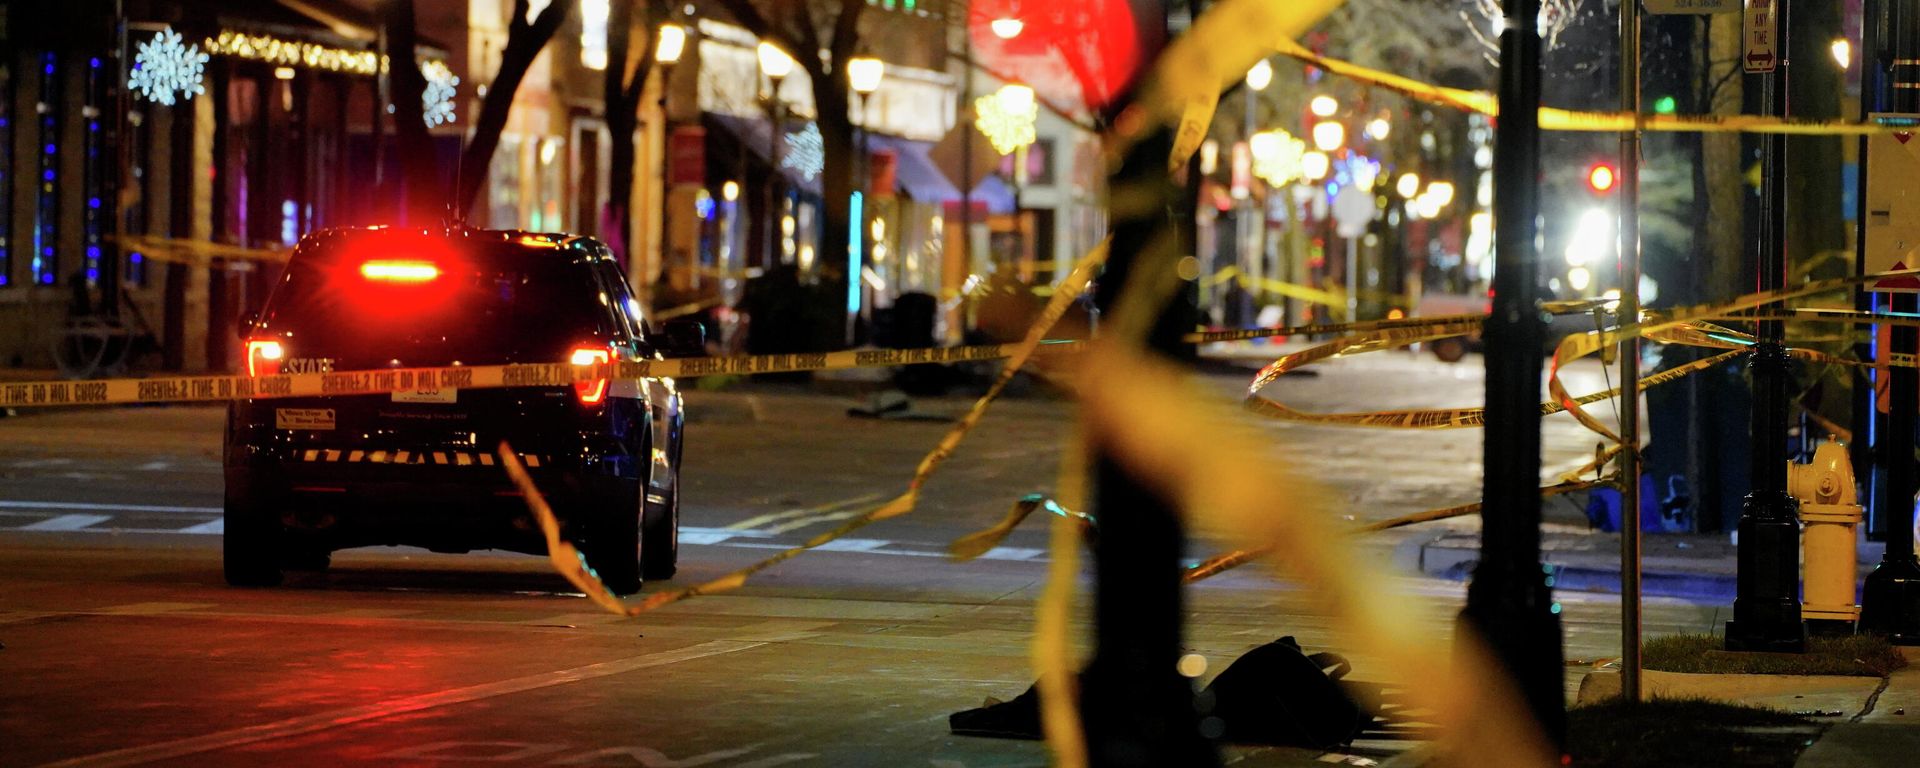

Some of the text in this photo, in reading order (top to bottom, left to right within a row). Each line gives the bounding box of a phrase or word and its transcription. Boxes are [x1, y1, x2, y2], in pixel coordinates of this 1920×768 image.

[1754, 13, 1768, 27] ANY
[1753, 30, 1768, 45] TIME
[288, 358, 335, 375] STATE
